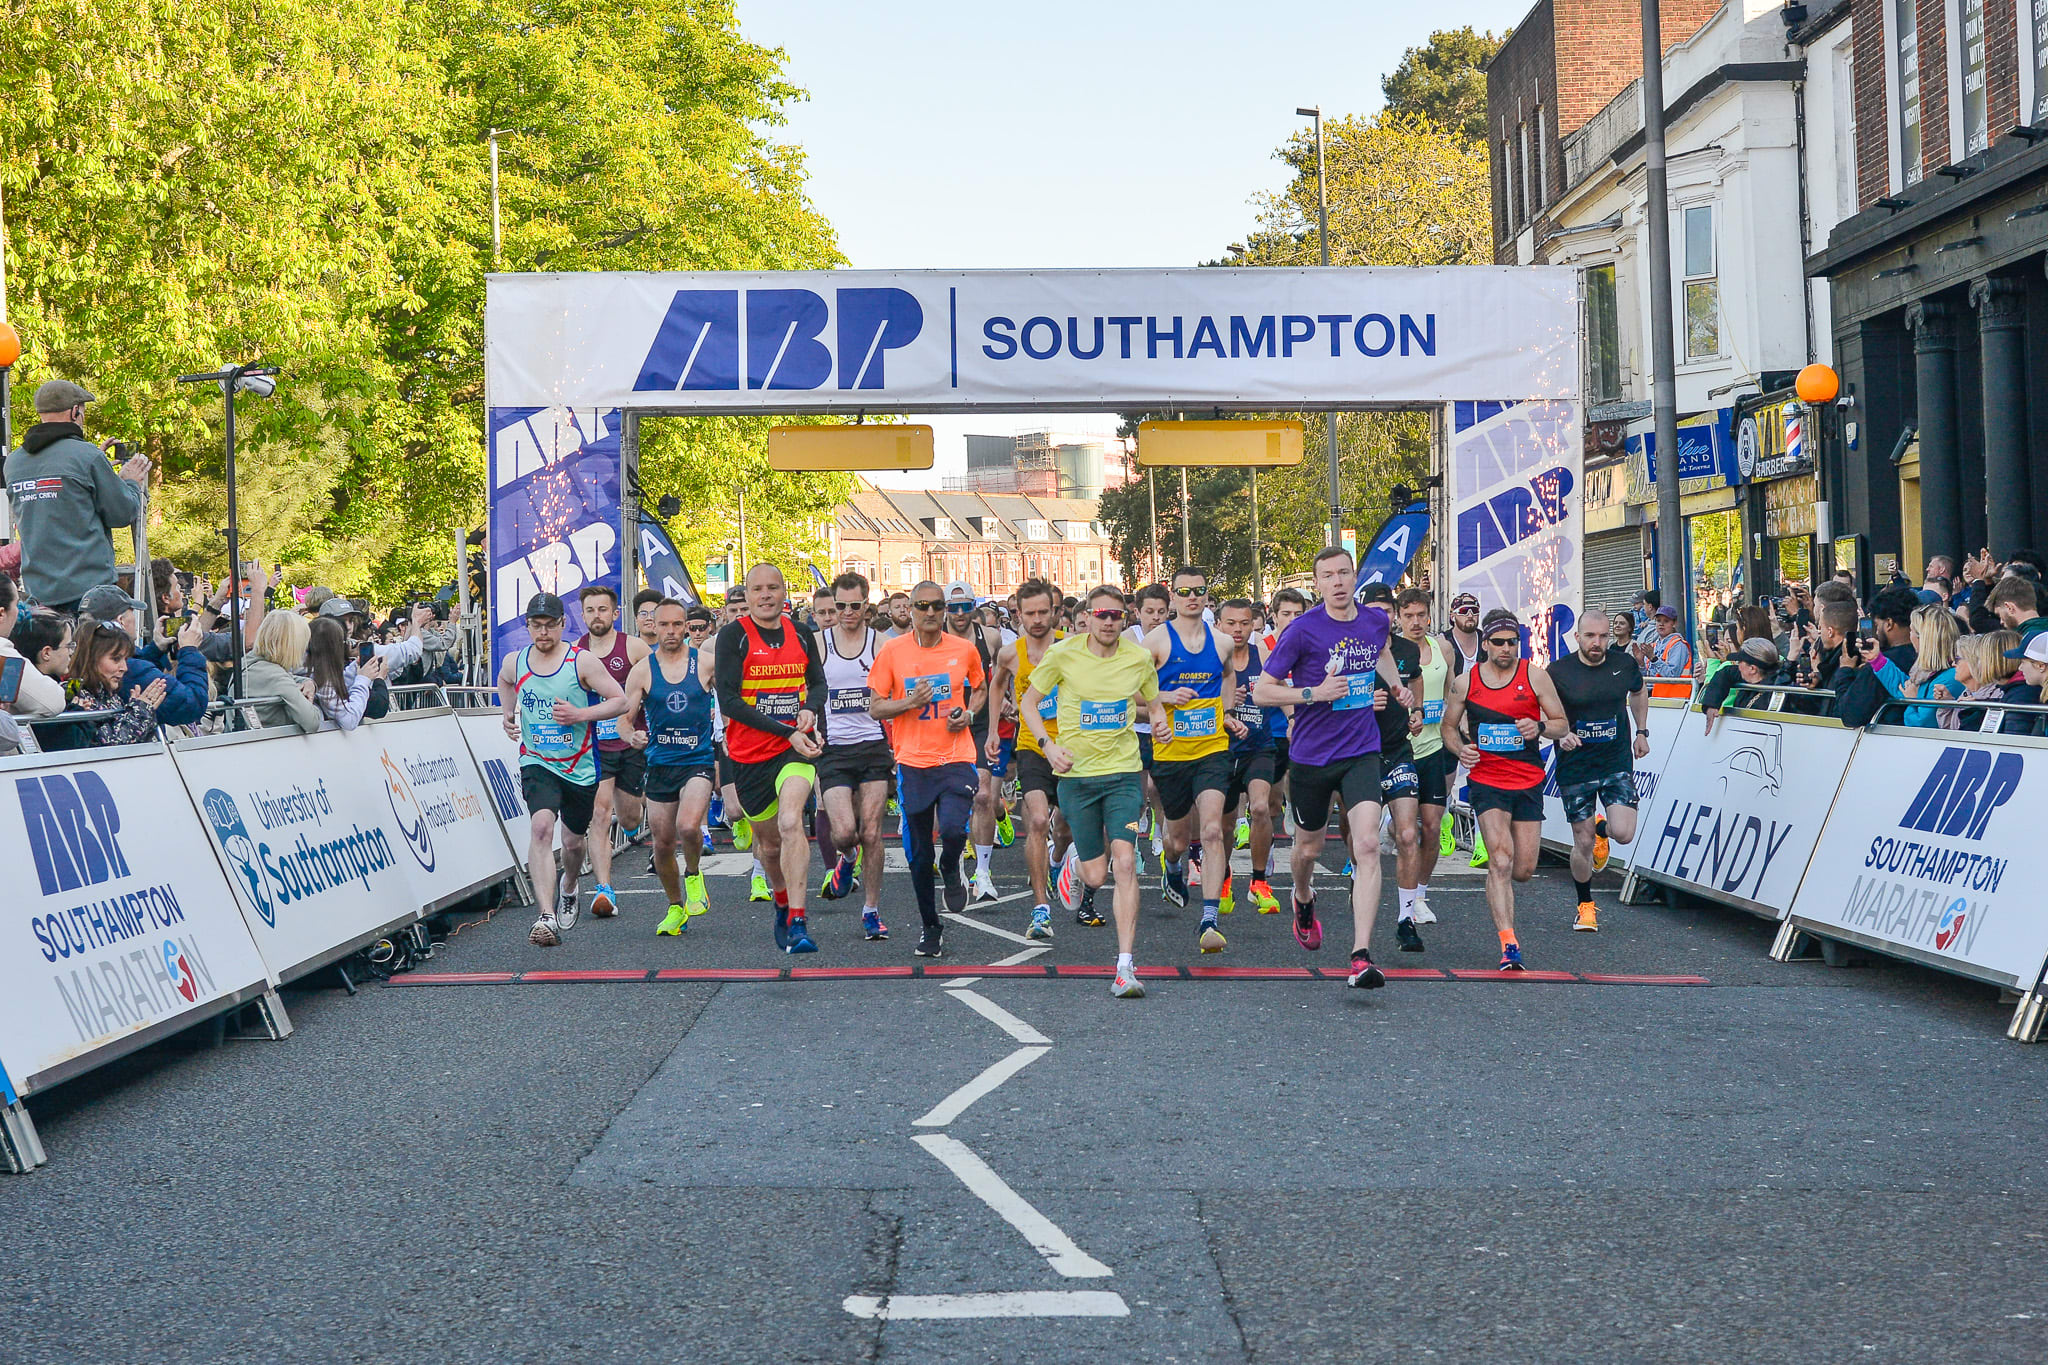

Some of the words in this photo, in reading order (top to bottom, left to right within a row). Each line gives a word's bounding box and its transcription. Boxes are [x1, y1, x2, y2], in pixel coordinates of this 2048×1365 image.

[1965, 67, 1985, 95] FAMILY
[632, 287, 924, 392] ABP
[982, 312, 1437, 361] SOUTHAMPTON
[496, 521, 616, 626] ABP
[749, 663, 806, 677] SERPENTINE
[1178, 672, 1213, 680] ROMSEY
[1348, 643, 1378, 661] Abby's
[1191, 720, 1207, 730] 7817
[403, 752, 461, 788] Southampton
[1898, 746, 2024, 841] ABP
[248, 783, 322, 831] University
[318, 777, 334, 816] of
[420, 792, 459, 833] Hospital
[450, 788, 485, 823] Charity
[15, 770, 132, 897] ABP
[1651, 799, 1794, 900] HENDY
[258, 823, 397, 905] Southampton
[1864, 835, 2009, 894] SOUTHAMPTON
[31, 883, 186, 963] SOUTHAMPTON
